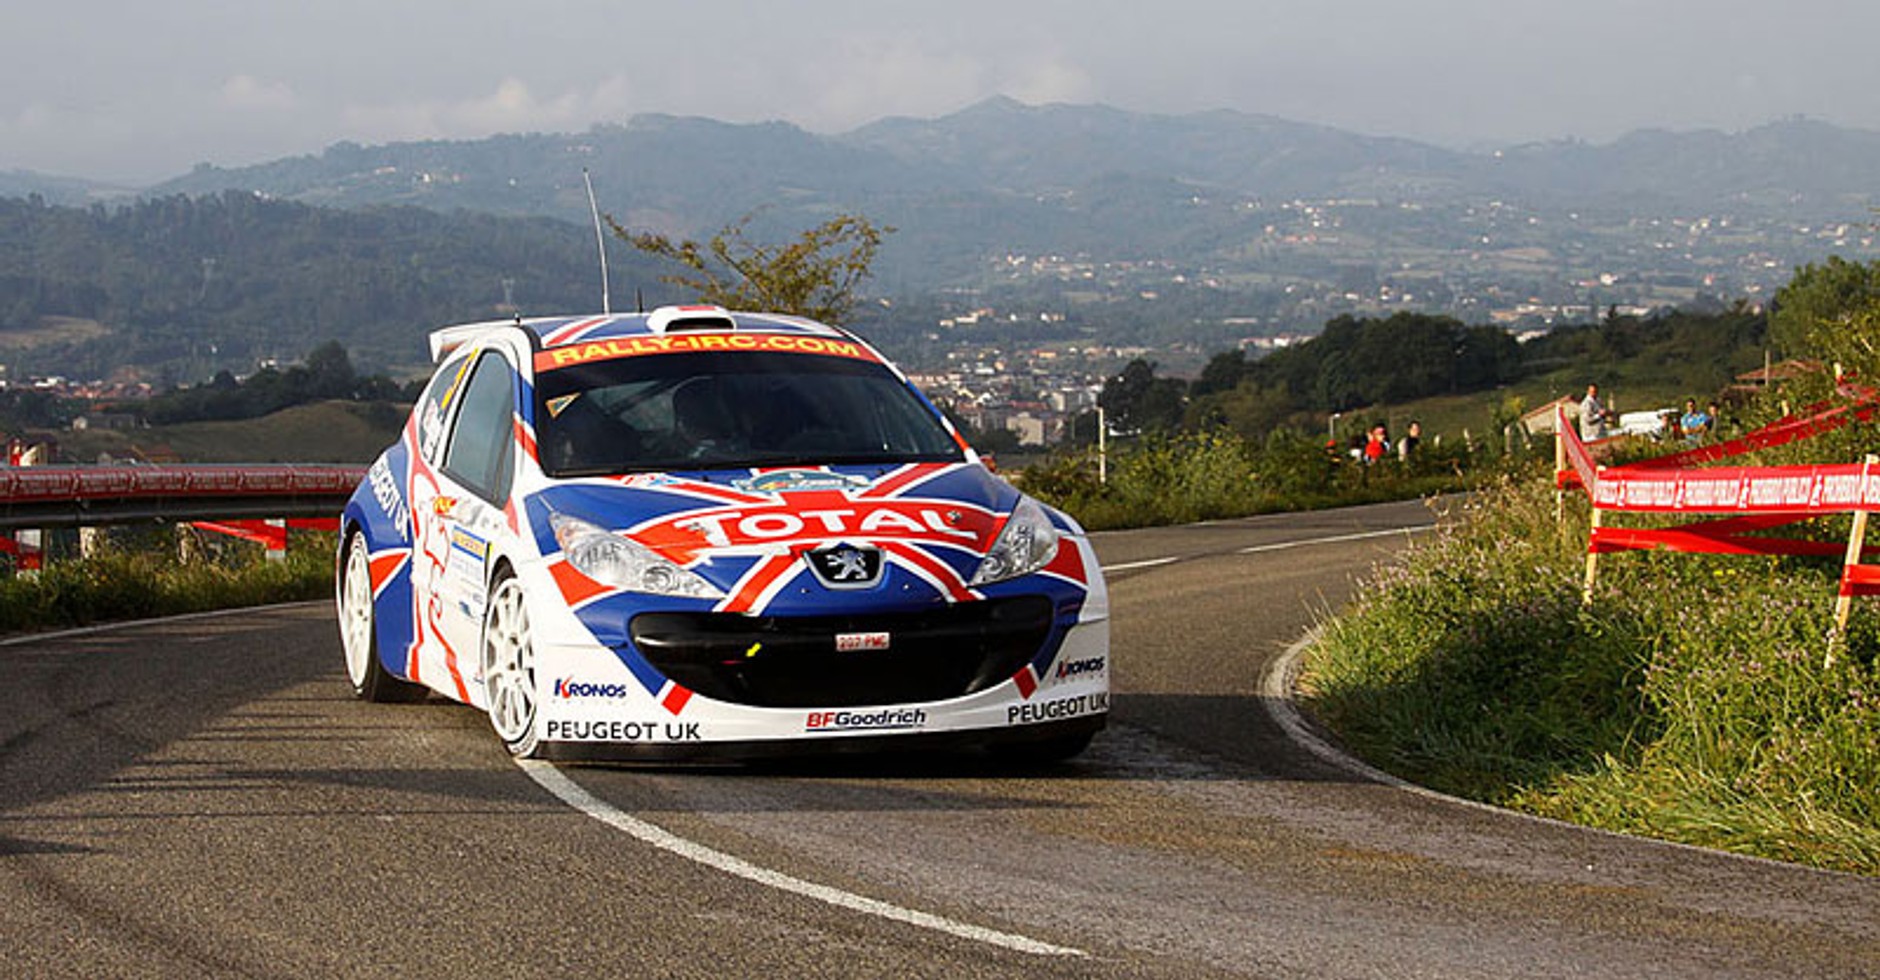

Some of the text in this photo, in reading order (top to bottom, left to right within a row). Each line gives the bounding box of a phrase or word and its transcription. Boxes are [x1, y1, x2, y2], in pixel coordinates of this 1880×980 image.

[552, 335, 861, 364] RALLY-IRC.COM
[673, 508, 978, 547] TOTAL
[806, 708, 927, 729] BFGoodrich
[1008, 695, 1087, 723] PEUGEOT
[547, 720, 658, 740] PEUGEOT
[664, 722, 702, 741] UK
